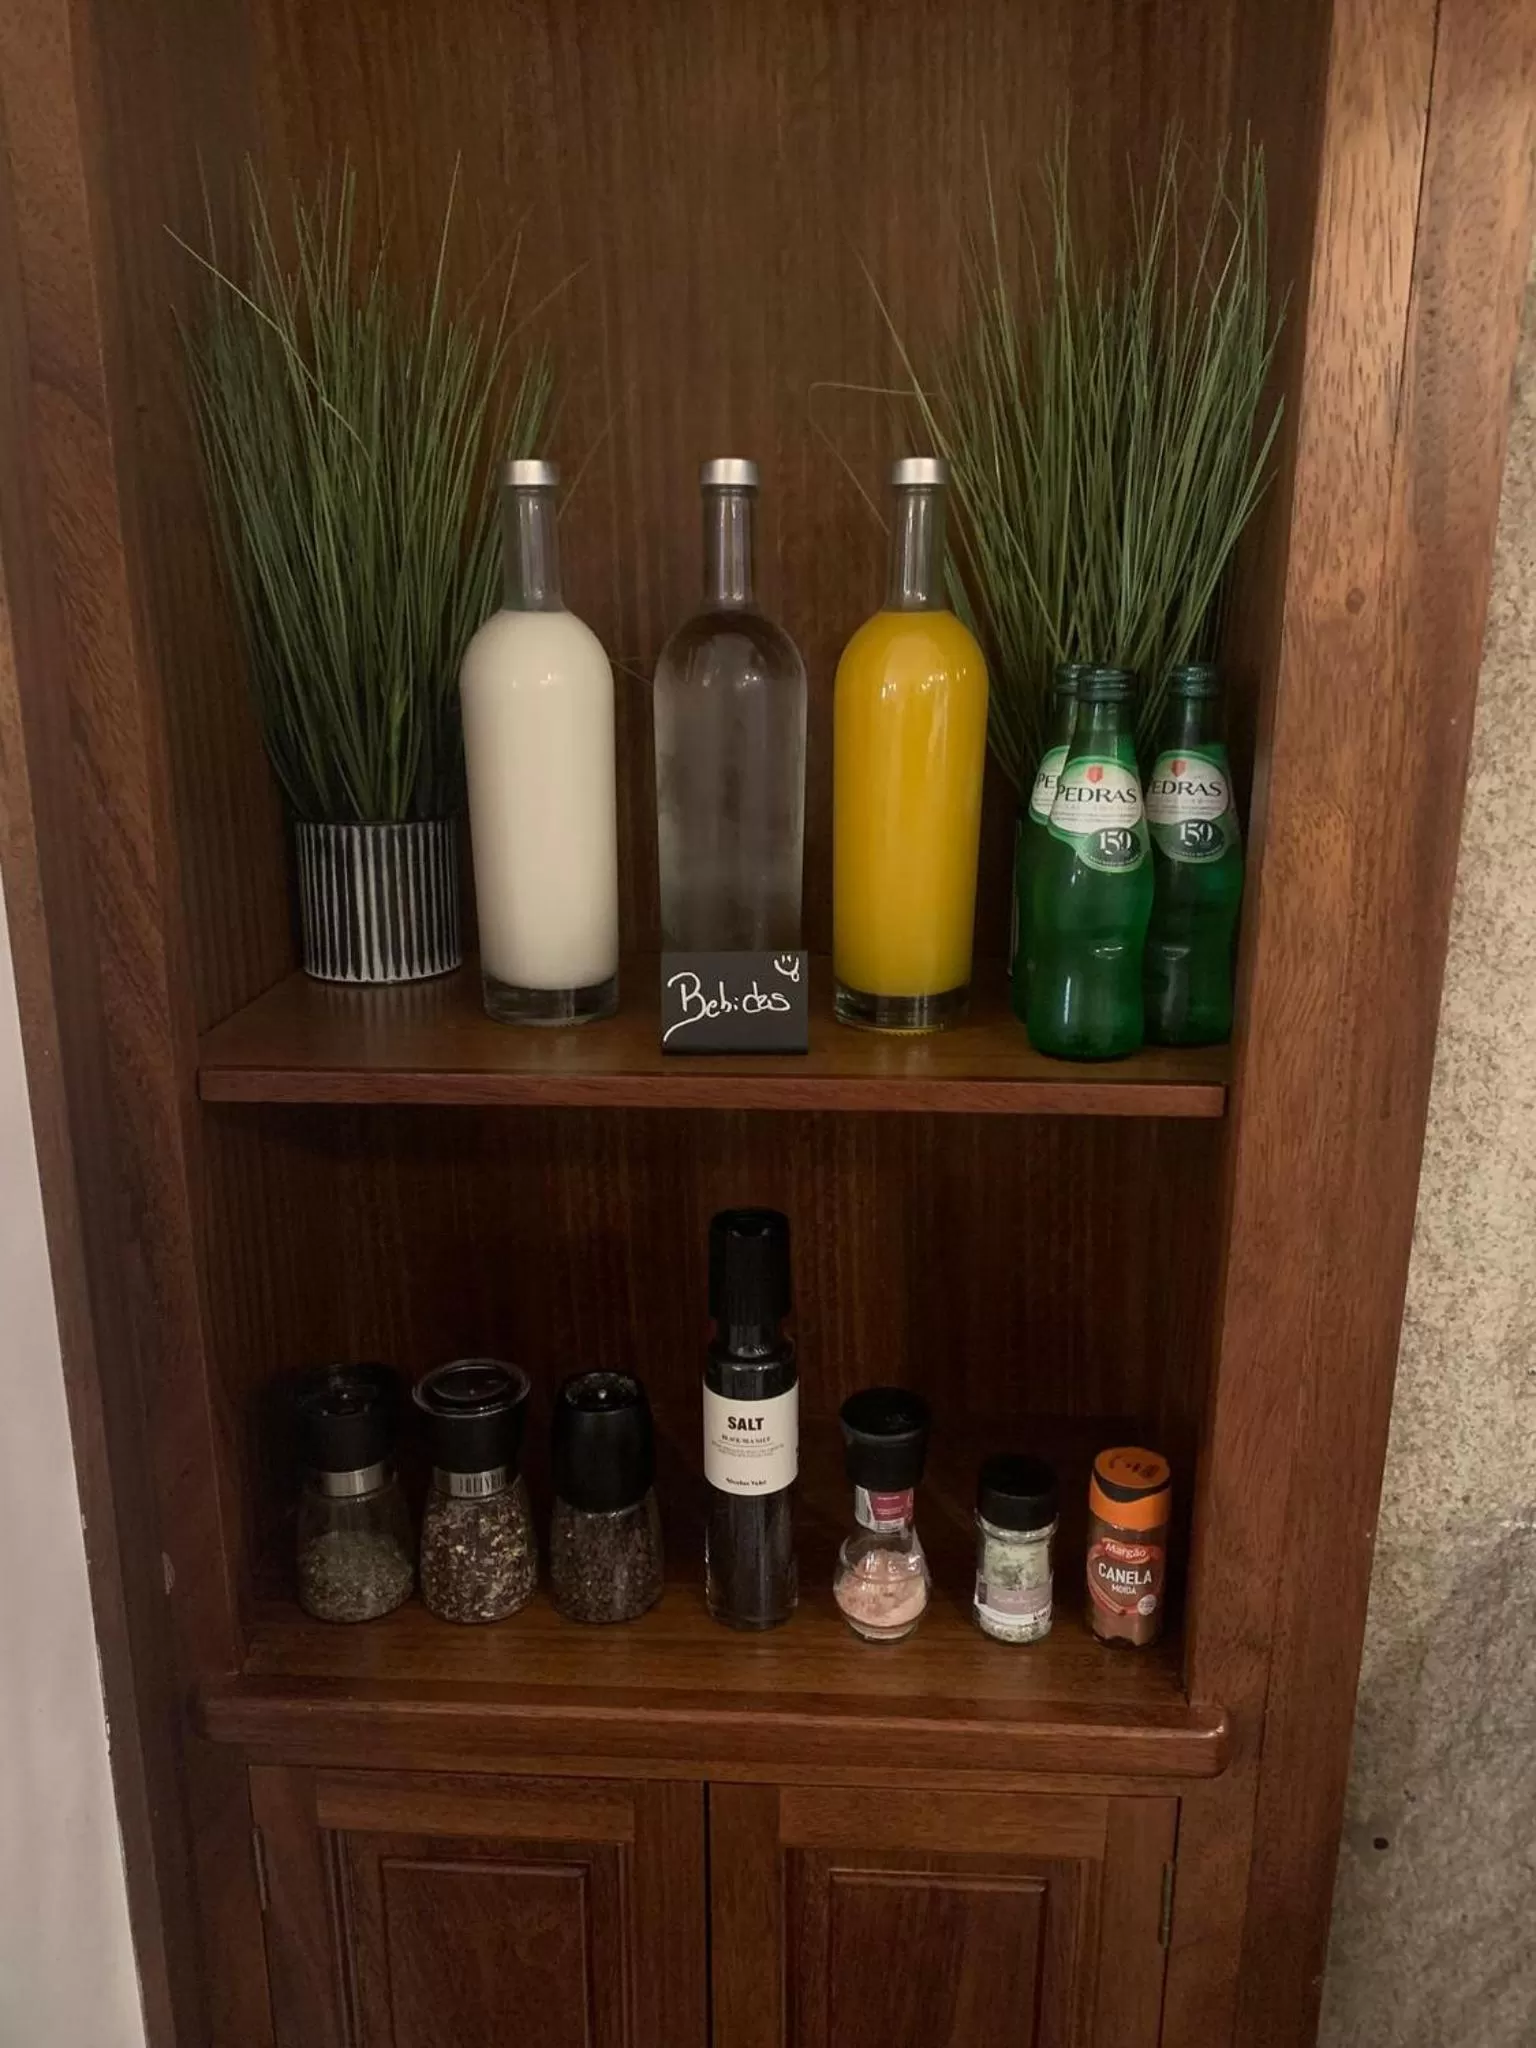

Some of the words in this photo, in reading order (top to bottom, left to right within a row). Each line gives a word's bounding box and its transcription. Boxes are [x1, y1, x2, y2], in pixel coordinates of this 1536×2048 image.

[1055, 784, 1138, 804] PEDRAS
[1151, 780, 1222, 797] EDRAS
[1100, 830, 1131, 856] 150
[1179, 822, 1213, 847] 150
[663, 971, 792, 1043] Bebidas
[727, 1415, 765, 1431] SALT
[1098, 1562, 1152, 1585] CANELA
